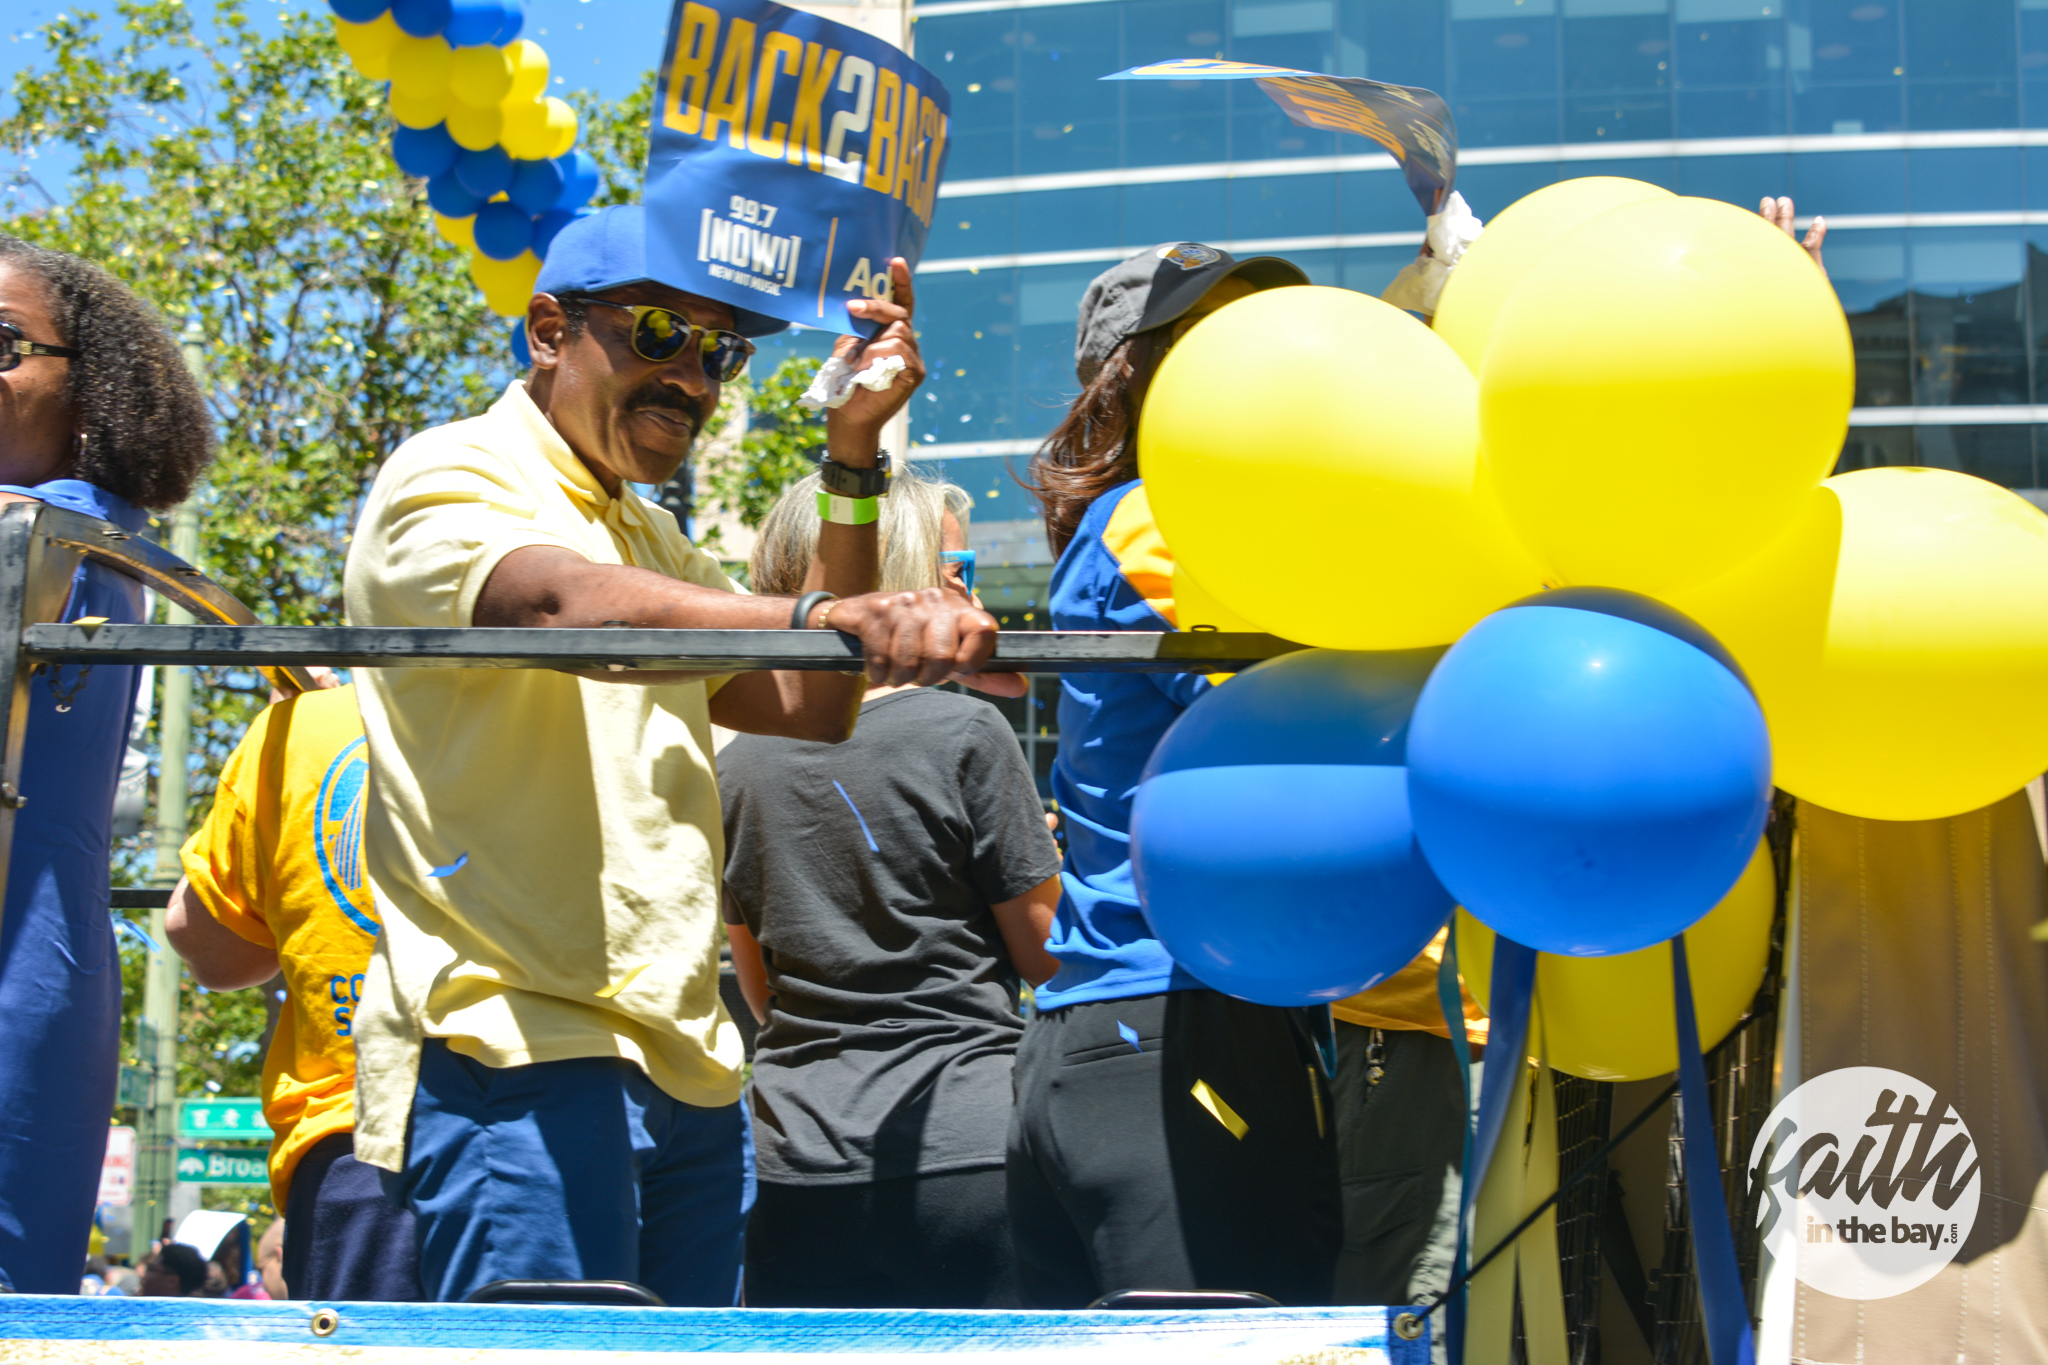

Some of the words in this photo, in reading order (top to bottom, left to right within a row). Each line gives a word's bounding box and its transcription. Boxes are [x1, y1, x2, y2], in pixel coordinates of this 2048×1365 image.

[728, 195, 778, 228] 99.7
[843, 257, 895, 303] Ad
[330, 973, 366, 1004] CO
[208, 1153, 268, 1177] Broa
